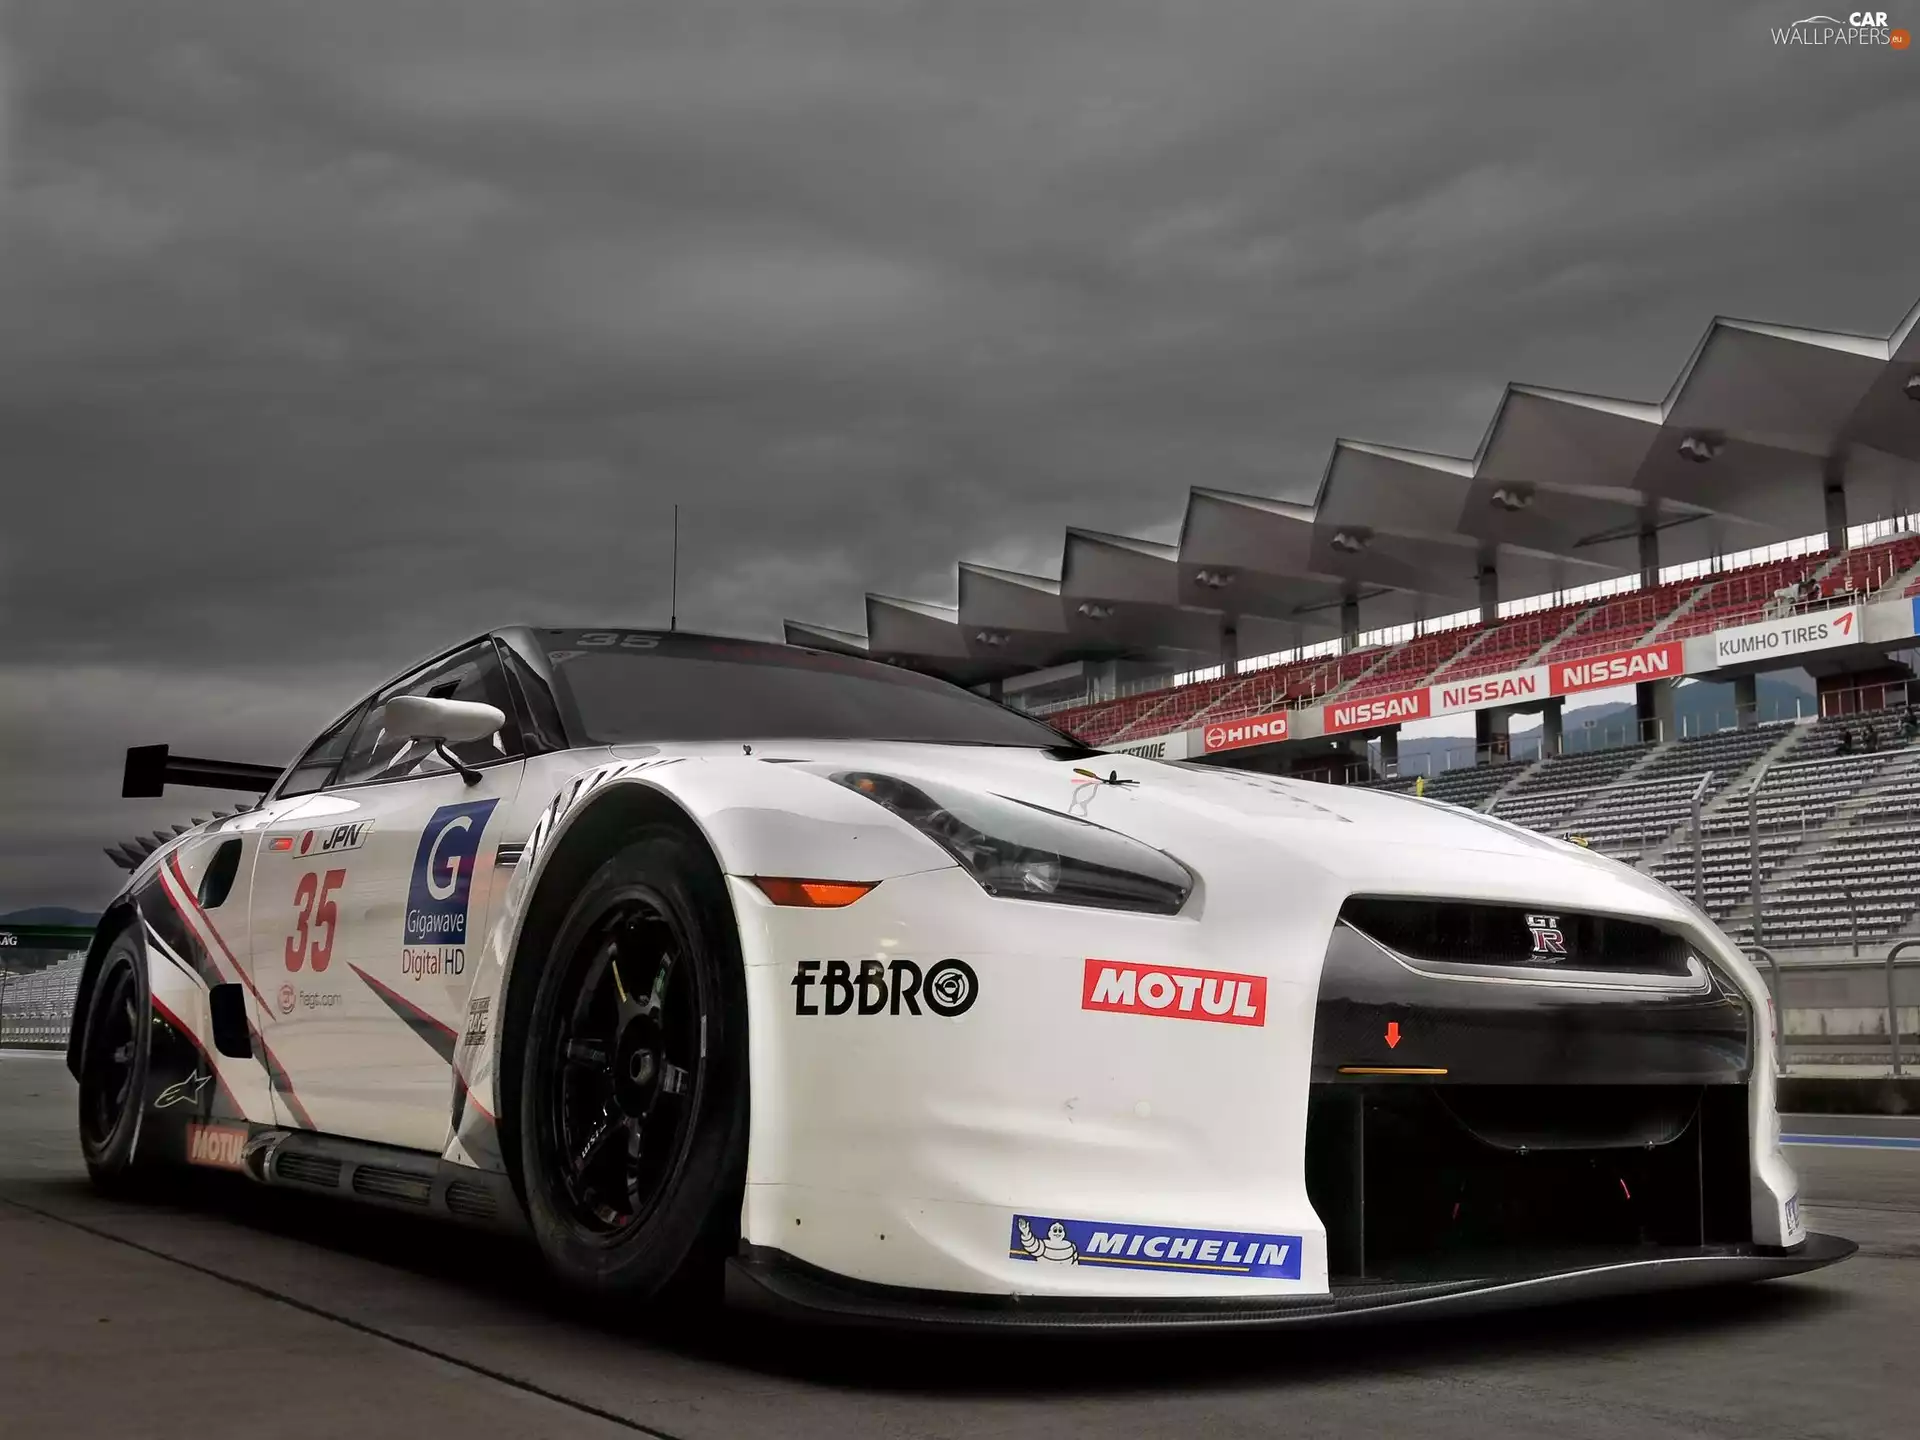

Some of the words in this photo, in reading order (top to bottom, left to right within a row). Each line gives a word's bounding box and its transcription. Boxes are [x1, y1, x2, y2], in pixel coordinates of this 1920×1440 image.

[576, 632, 663, 648] 35
[1720, 631, 1779, 656] KUMHO
[1782, 624, 1829, 646] TIRES
[1562, 650, 1669, 688] NISSAN
[1443, 675, 1535, 708] NISSAN
[1334, 695, 1418, 727] NISSAN
[1228, 719, 1287, 742] HINO
[323, 823, 365, 850] JPN
[426, 816, 473, 900] G
[285, 869, 346, 972] 35
[407, 909, 464, 939] Gigawave
[1525, 914, 1560, 928] GT
[1529, 928, 1567, 953] R
[402, 948, 441, 981] Digital
[444, 948, 465, 975] HD
[791, 958, 979, 1017] EBBRO
[1090, 968, 1257, 1018] MOTUL
[1086, 1231, 1289, 1266] MICHELIN
